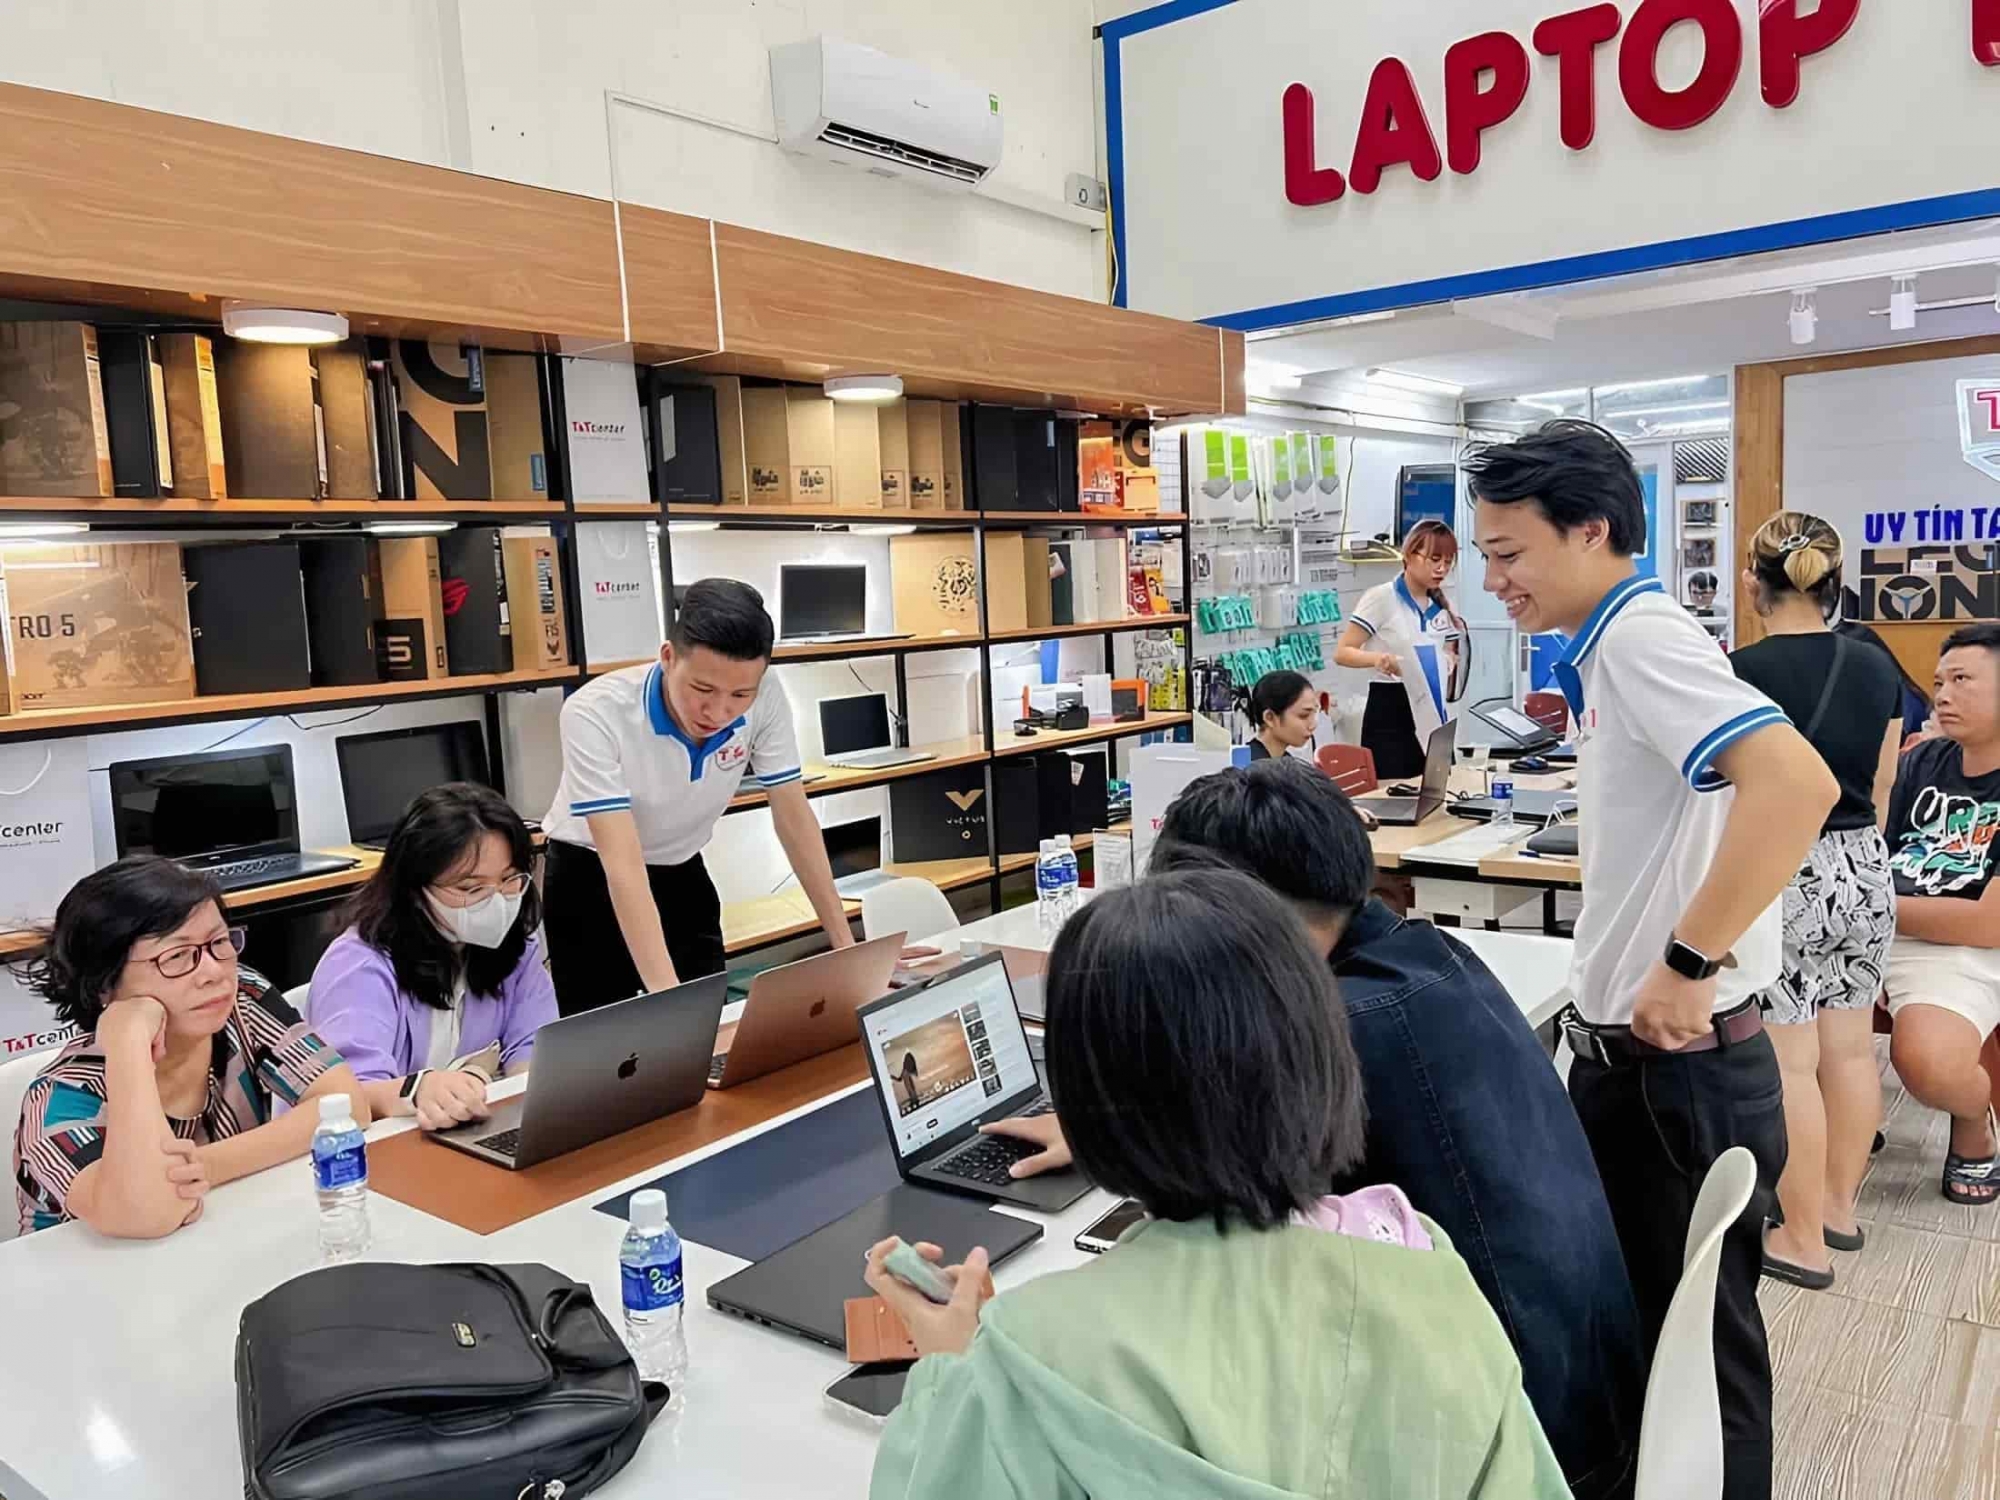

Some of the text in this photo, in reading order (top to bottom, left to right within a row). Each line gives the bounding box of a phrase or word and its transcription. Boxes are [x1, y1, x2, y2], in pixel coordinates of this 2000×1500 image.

[1283, 0, 1861, 207] LAPTOP
[1865, 511, 1906, 543] UY
[1914, 504, 1963, 541] TÍN
[61, 614, 76, 637] 5
[0, 822, 64, 838] center
